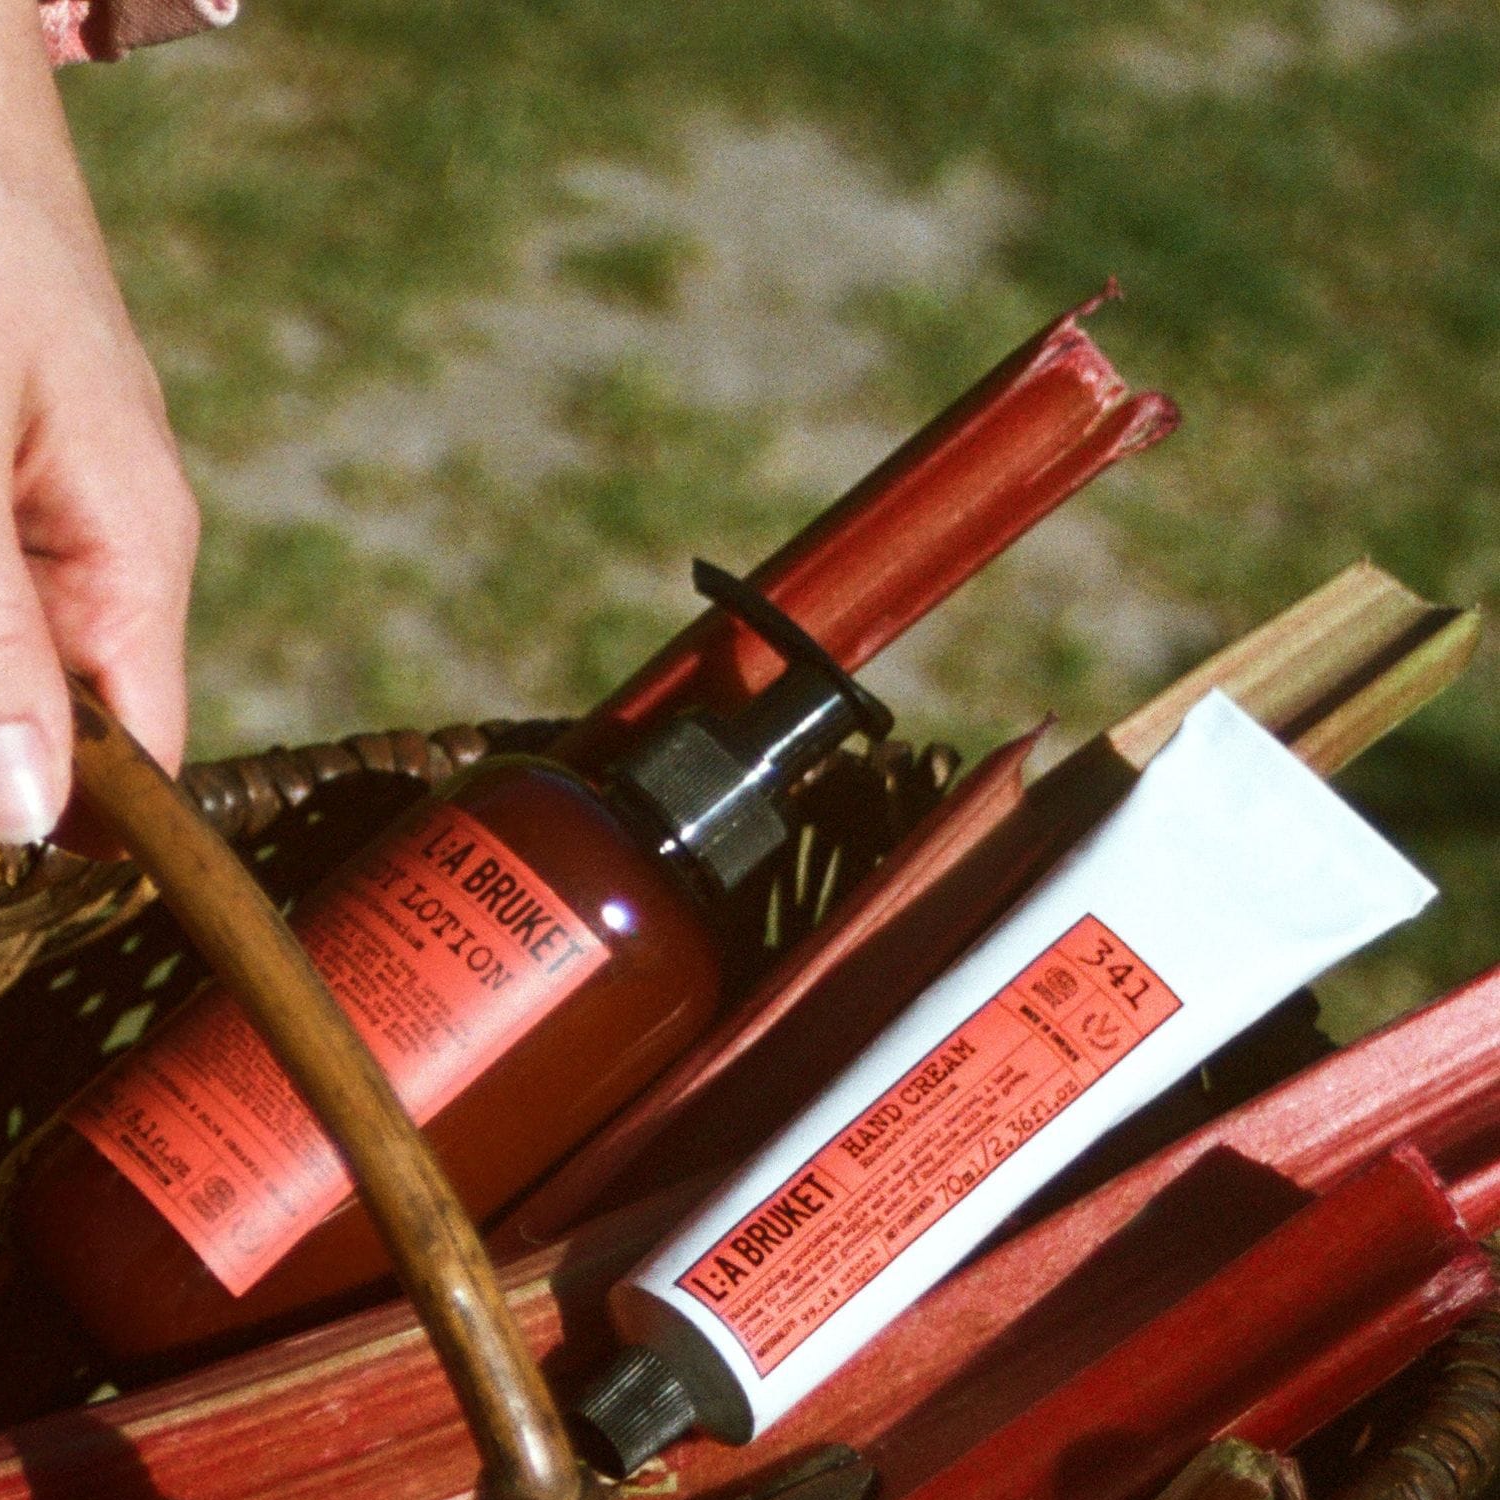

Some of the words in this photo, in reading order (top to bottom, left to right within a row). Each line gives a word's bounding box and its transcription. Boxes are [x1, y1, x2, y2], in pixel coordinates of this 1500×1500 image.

[396, 880, 516, 994] LOTION
[420, 822, 478, 878] L:A
[458, 855, 580, 976] BRUKET
[1076, 934, 1154, 1014] 341
[837, 1100, 904, 1160] HAND
[896, 1034, 978, 1108] CREAM
[931, 1068, 1080, 1206] 70ml/2.36fl.oz
[688, 1250, 750, 1306] L:A
[728, 1170, 836, 1269] BRUKET
